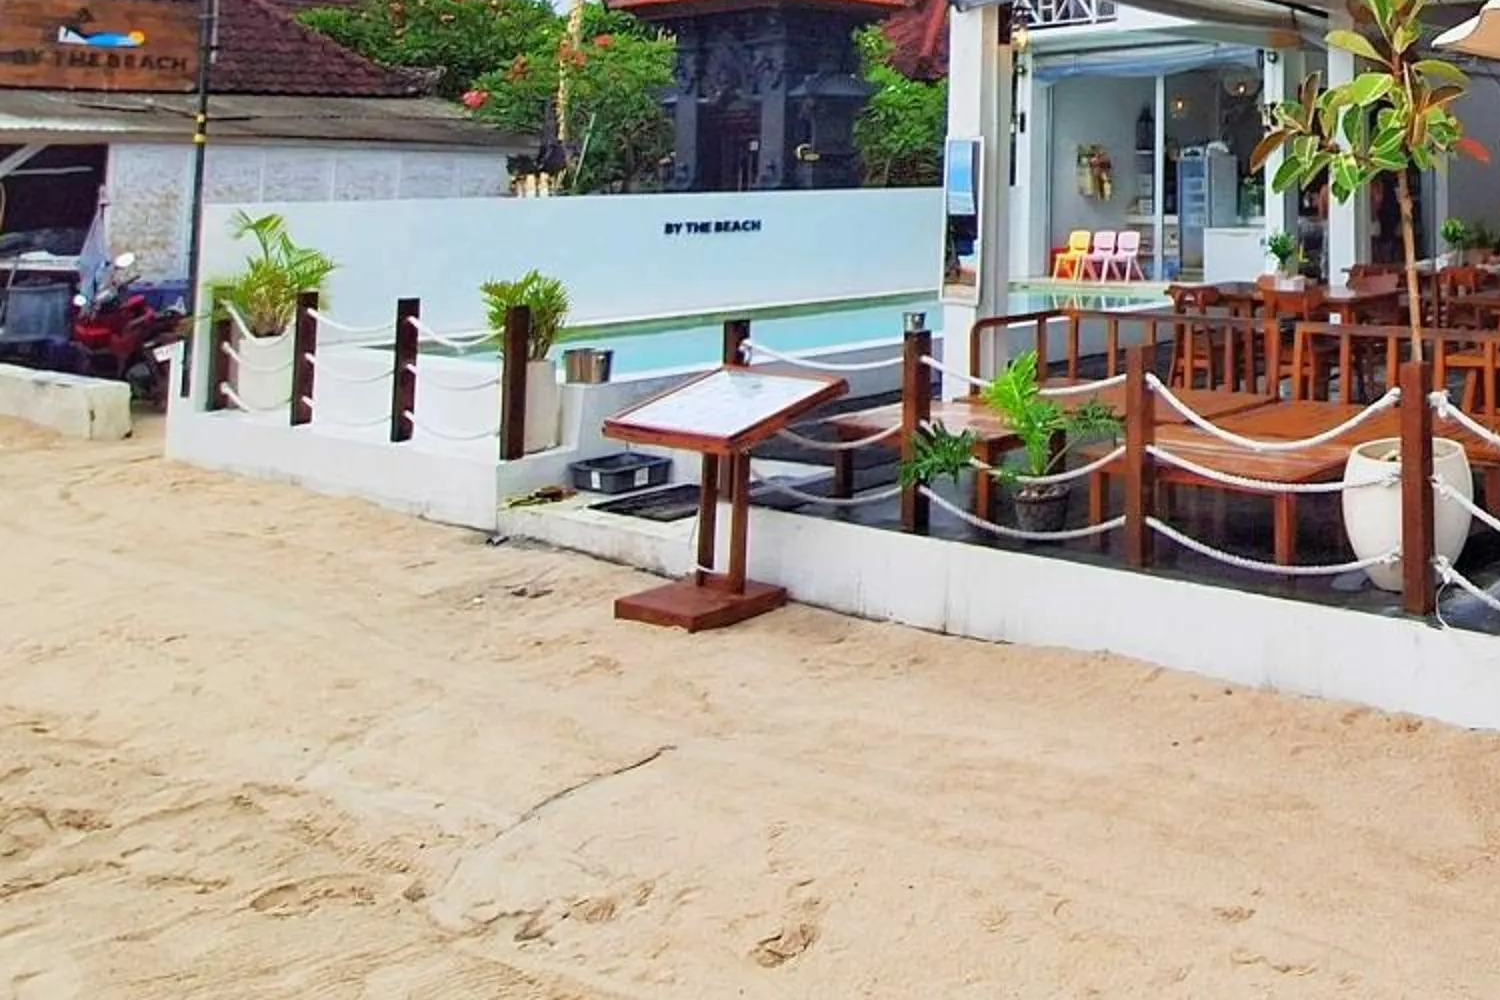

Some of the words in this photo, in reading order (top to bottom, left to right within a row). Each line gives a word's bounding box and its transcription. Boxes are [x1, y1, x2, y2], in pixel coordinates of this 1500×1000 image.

[12, 49, 41, 66] BY
[54, 51, 100, 69] THE
[107, 53, 188, 71] BEACH
[664, 222, 682, 235] BY
[685, 221, 712, 233] THE
[714, 219, 762, 232] BEACH
